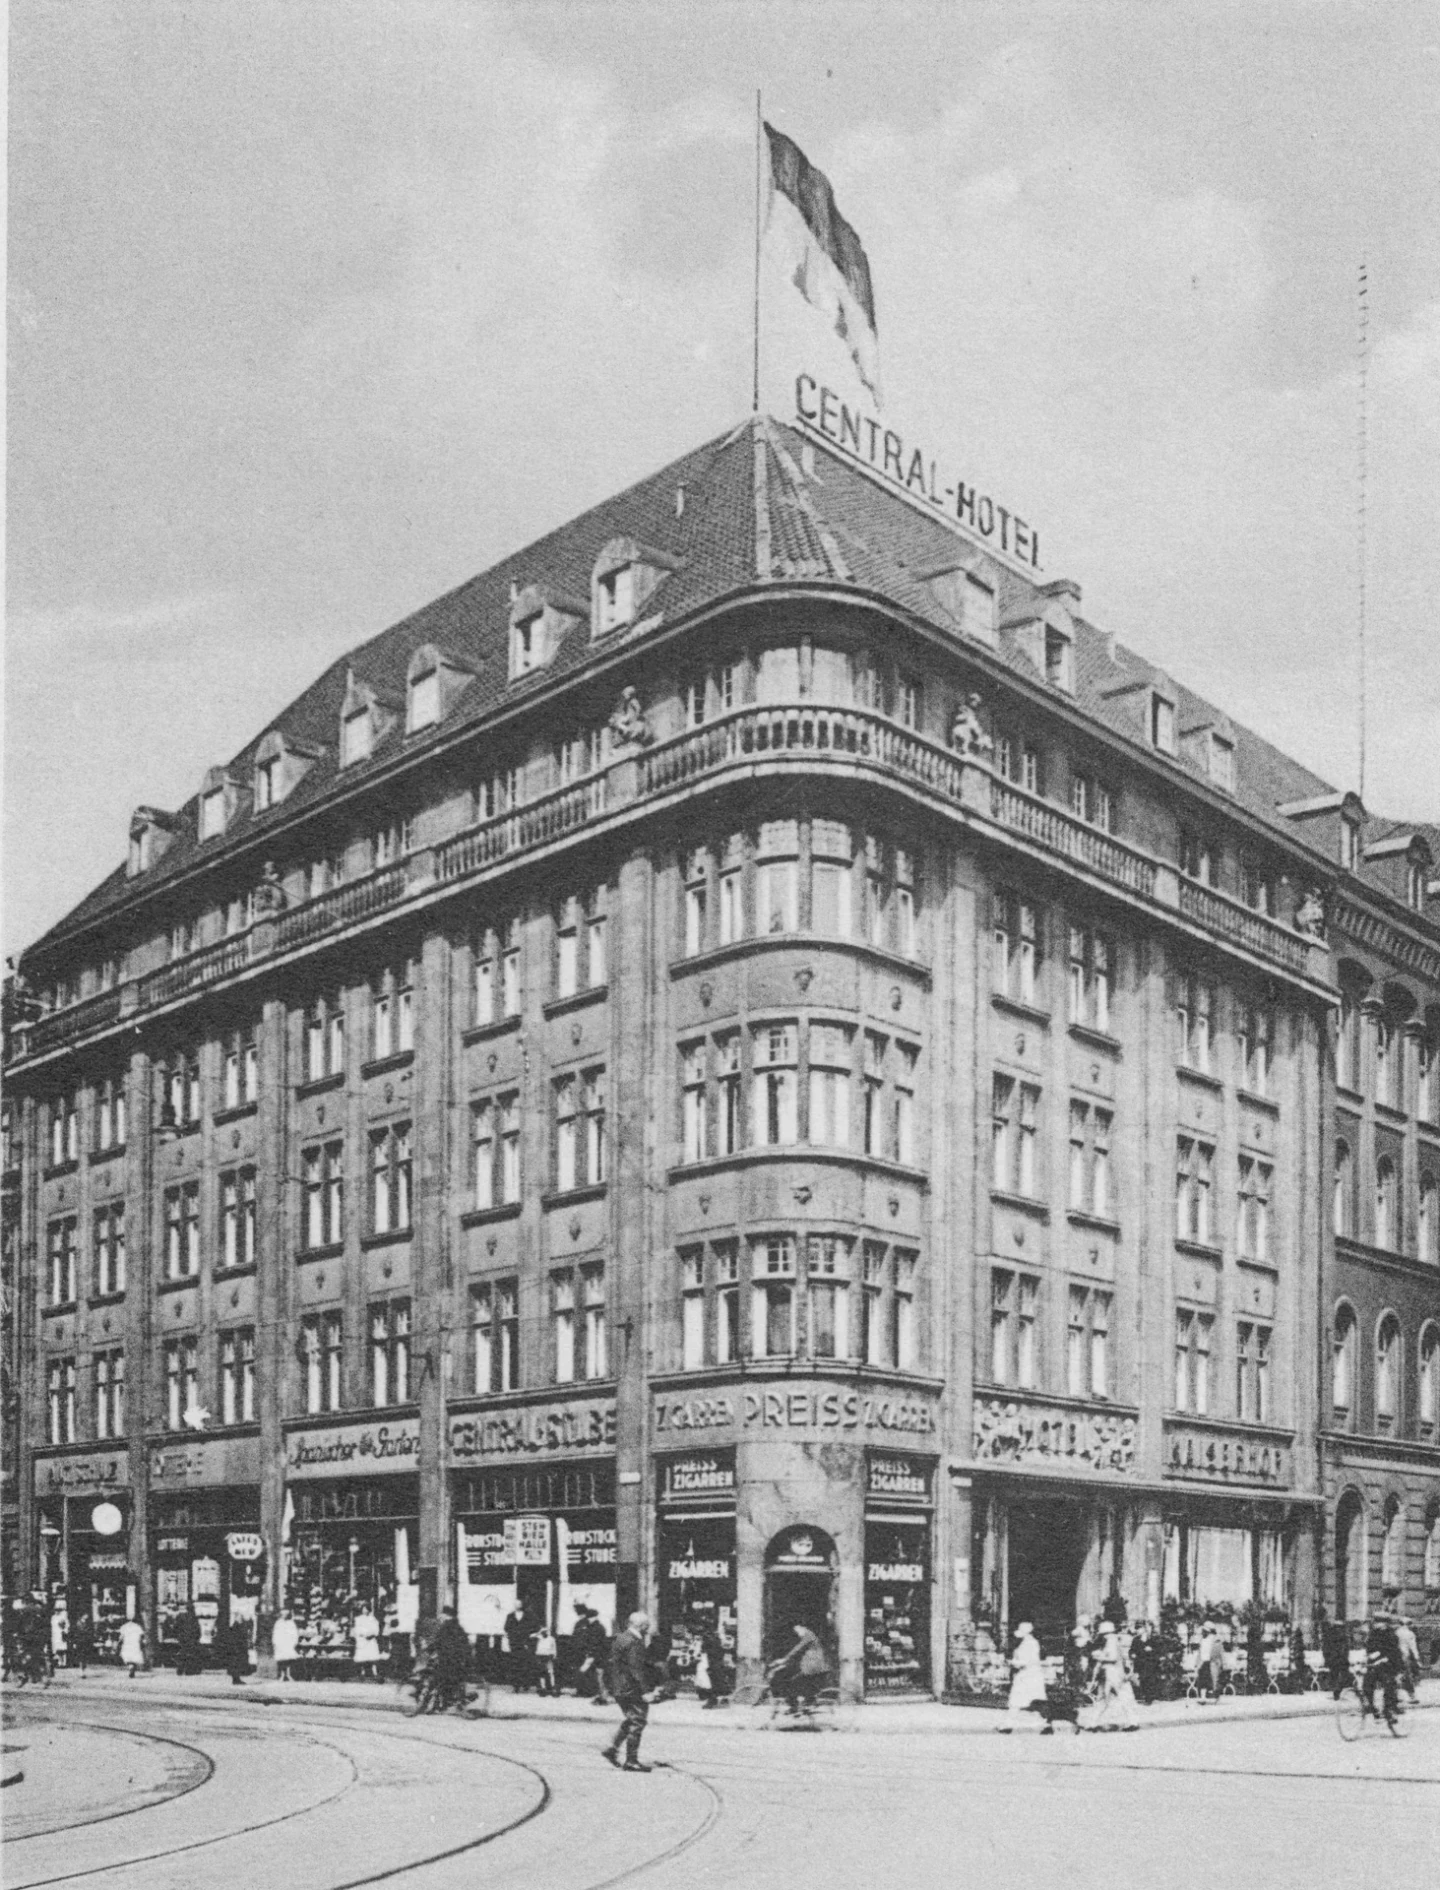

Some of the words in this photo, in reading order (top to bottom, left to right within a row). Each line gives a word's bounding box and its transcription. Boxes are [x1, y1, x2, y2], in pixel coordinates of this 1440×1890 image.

[795, 373, 1043, 571] CENTRAL-HOTEL
[742, 1393, 858, 1429] PREISS
[673, 1470, 733, 1490] ZIGARREN
[870, 1473, 925, 1493] ZIGARREN
[668, 1560, 729, 1579] ZIGARREN
[868, 1563, 923, 1582] ZIGARREN
